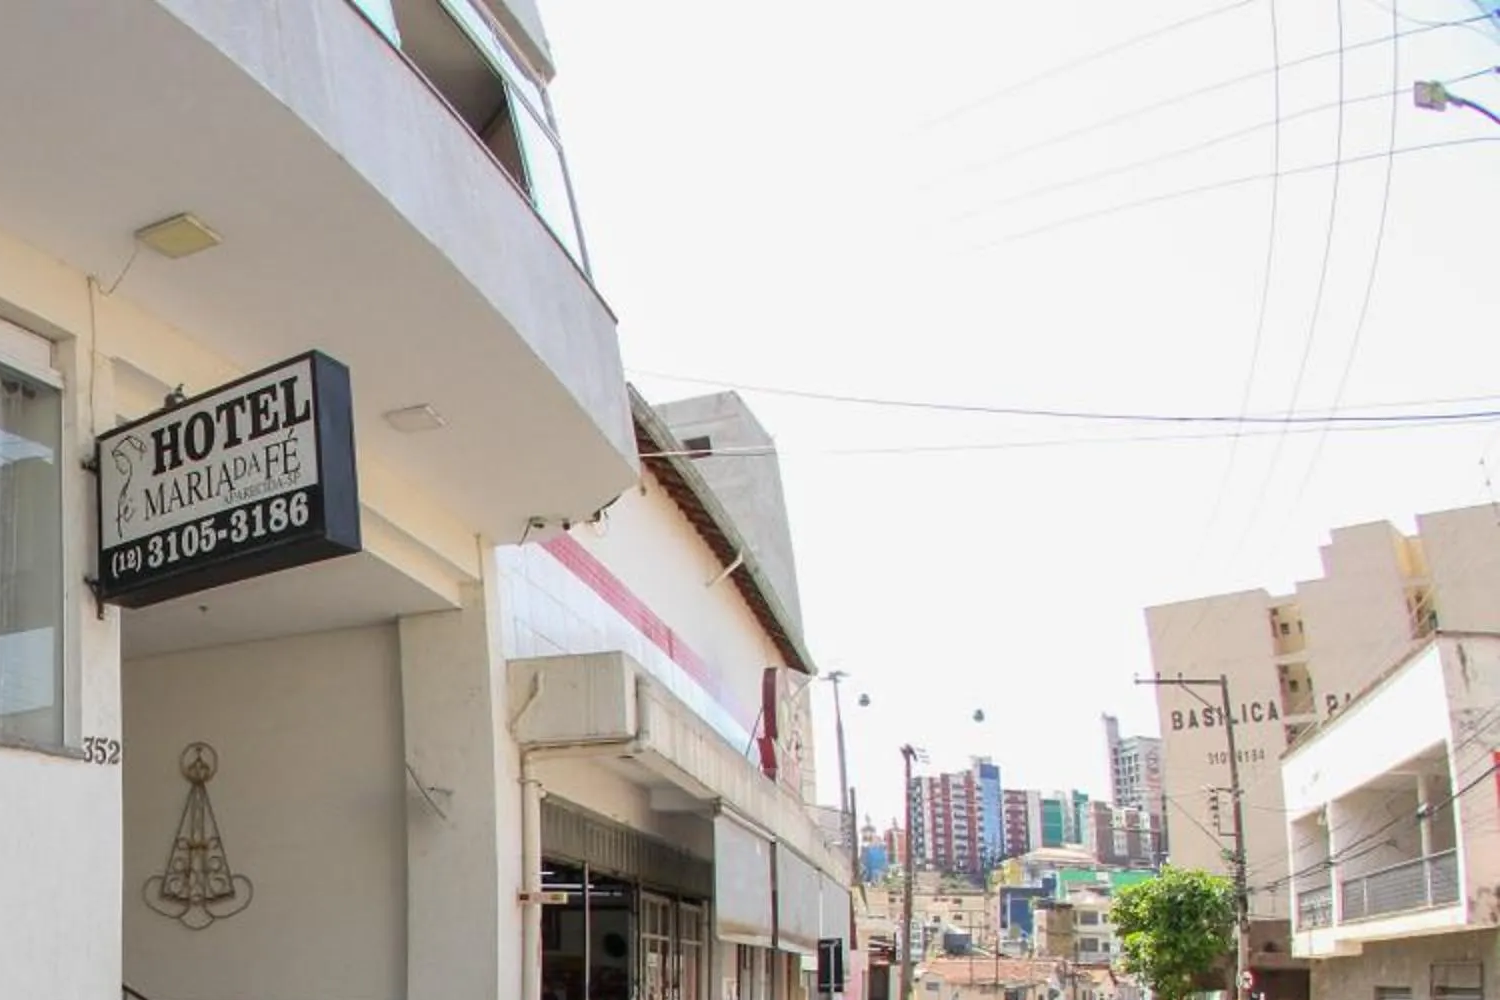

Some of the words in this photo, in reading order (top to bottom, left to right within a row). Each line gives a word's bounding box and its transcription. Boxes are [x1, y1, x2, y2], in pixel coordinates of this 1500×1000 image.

[151, 376, 311, 476] HOTEL
[142, 456, 236, 521] MARIA
[265, 428, 301, 480] FÉ
[111, 545, 142, 578] (12)
[148, 492, 309, 568] 3105-3186
[83, 736, 120, 765] 352
